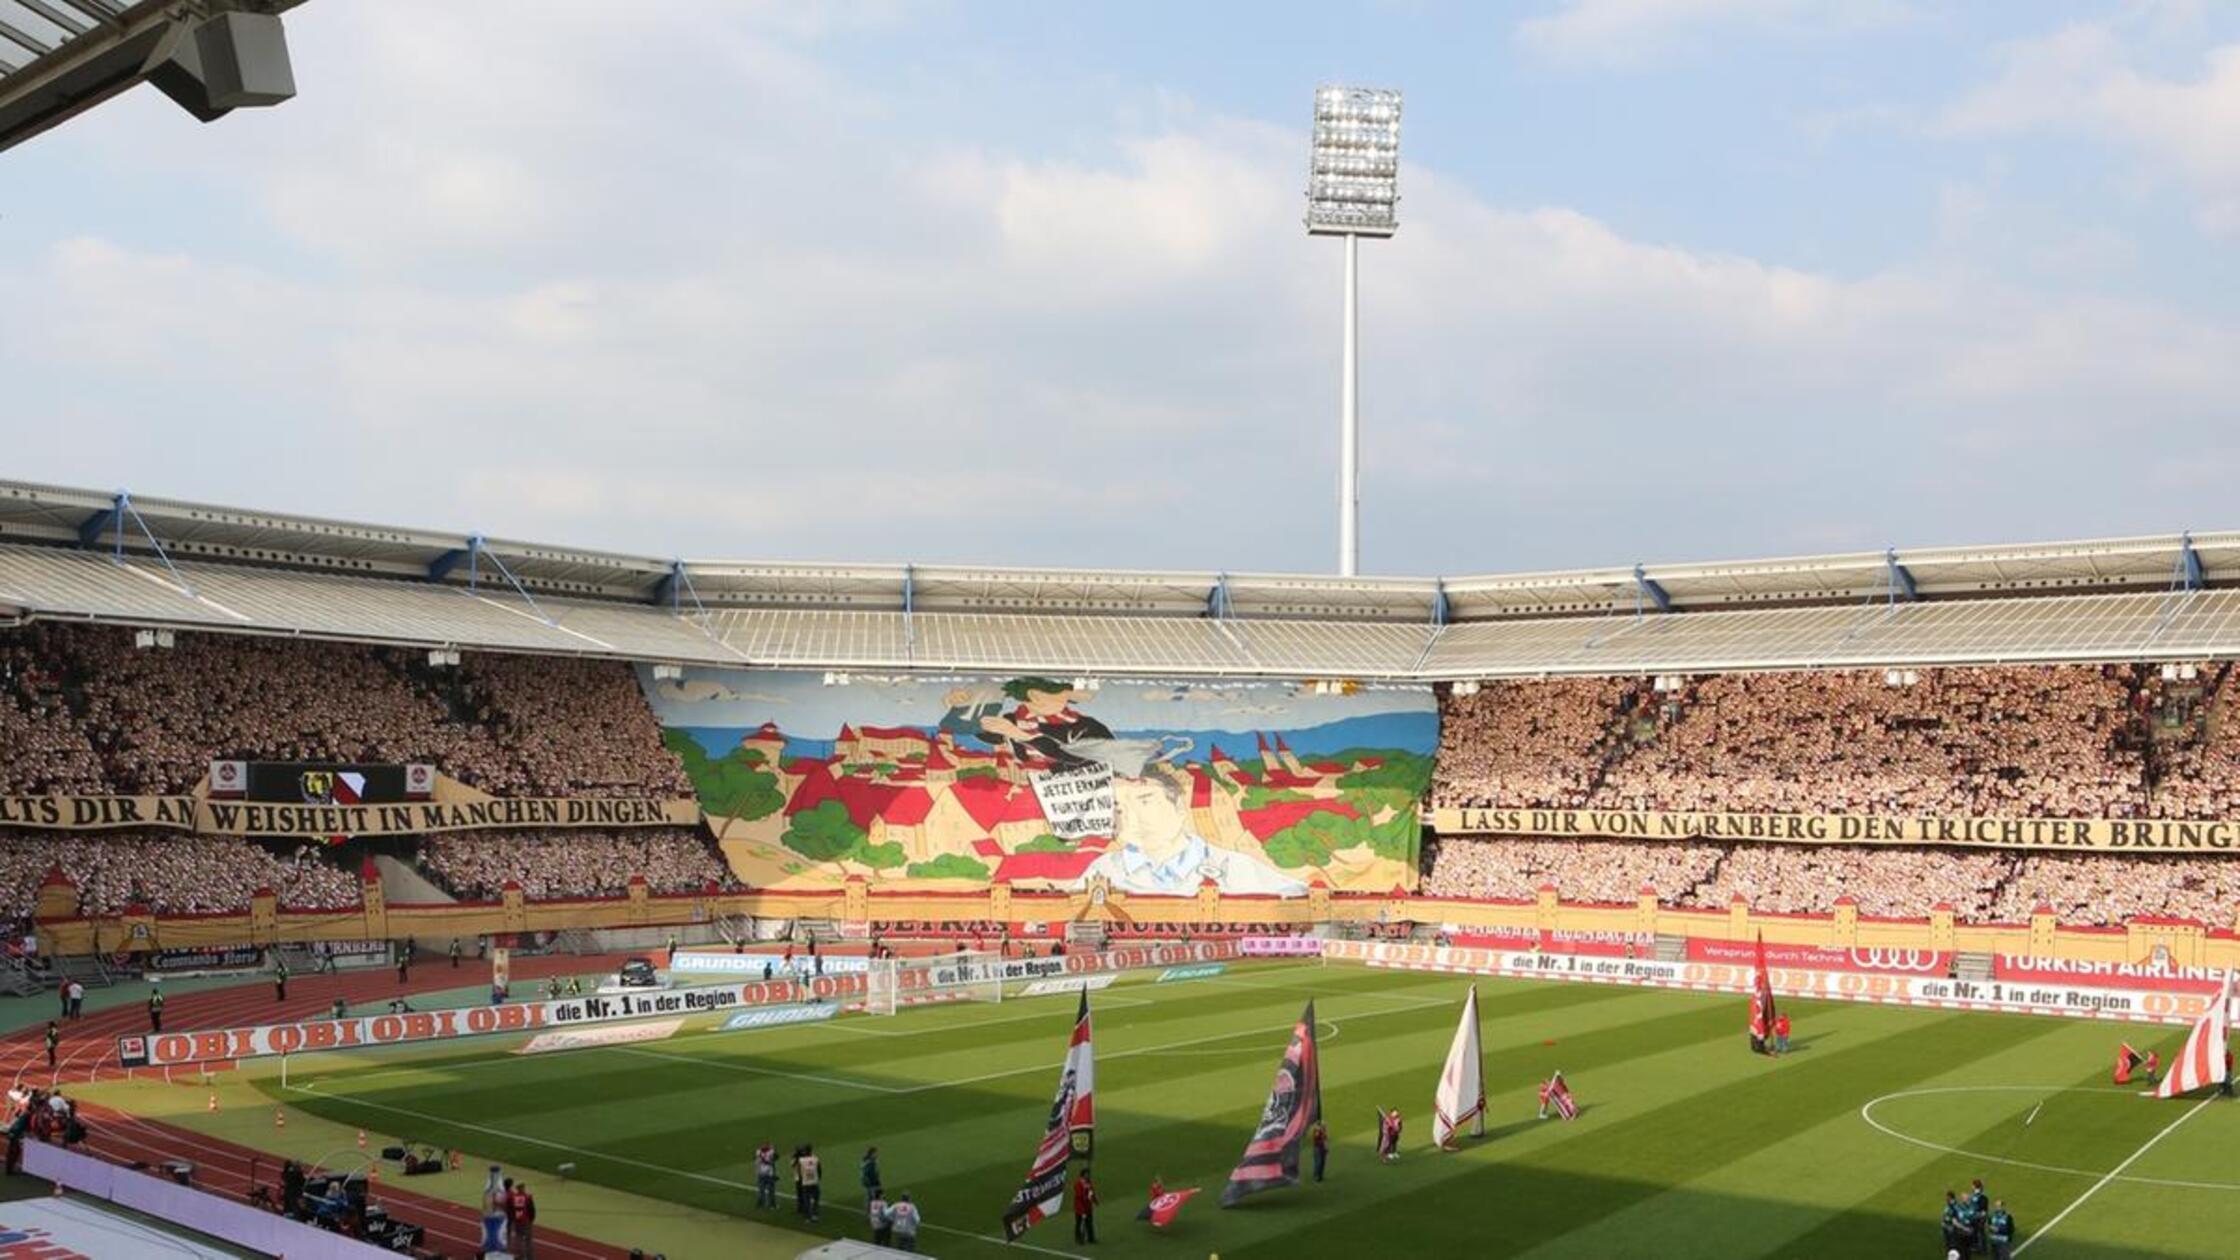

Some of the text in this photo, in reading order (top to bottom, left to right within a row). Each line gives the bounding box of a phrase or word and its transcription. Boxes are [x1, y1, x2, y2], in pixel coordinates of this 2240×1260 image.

[73, 797, 142, 825] DIR
[155, 797, 194, 824] AN
[208, 803, 368, 833] WEISHEIT
[380, 808, 412, 832] IN
[424, 800, 558, 828] MANCHEN
[567, 799, 672, 825] DINGEN,
[1460, 810, 1521, 832] LASS
[1532, 811, 1581, 833] DIR
[1591, 812, 1649, 835] VON
[1840, 817, 1904, 841] DEN
[1916, 817, 2095, 846] TRICHTER
[2110, 822, 2240, 849] BRING
[1704, 945, 1756, 959] Vorsprun
[2003, 953, 2112, 975] TURKISH
[1513, 955, 1533, 969] die
[1537, 954, 1562, 970] Nr.
[1568, 956, 1576, 971] 1
[1580, 959, 1593, 972] in
[1597, 959, 1619, 974] der
[1625, 961, 1675, 981] Region
[1923, 981, 1948, 998] die
[1954, 981, 1985, 1000] Nr.
[1992, 984, 2003, 1001] 1
[2009, 987, 2024, 1002] in
[2031, 988, 2058, 1005] der
[2066, 991, 2131, 1012] Region
[2143, 993, 2208, 1017] OB
[155, 1029, 256, 1063] OBI
[268, 1019, 362, 1053] OBI
[371, 1012, 459, 1042] OBI
[467, 1004, 547, 1033] OBI
[556, 1003, 582, 1022] die
[586, 998, 617, 1019] Nr.
[623, 996, 633, 1015] 1
[637, 996, 651, 1013] in
[656, 993, 681, 1012] der
[685, 990, 737, 1012] Region
[938, 968, 955, 984] die
[957, 964, 980, 982] Nr.
[1006, 961, 1023, 976] der
[1026, 959, 1062, 978] Region
[1066, 954, 1108, 973] OBI
